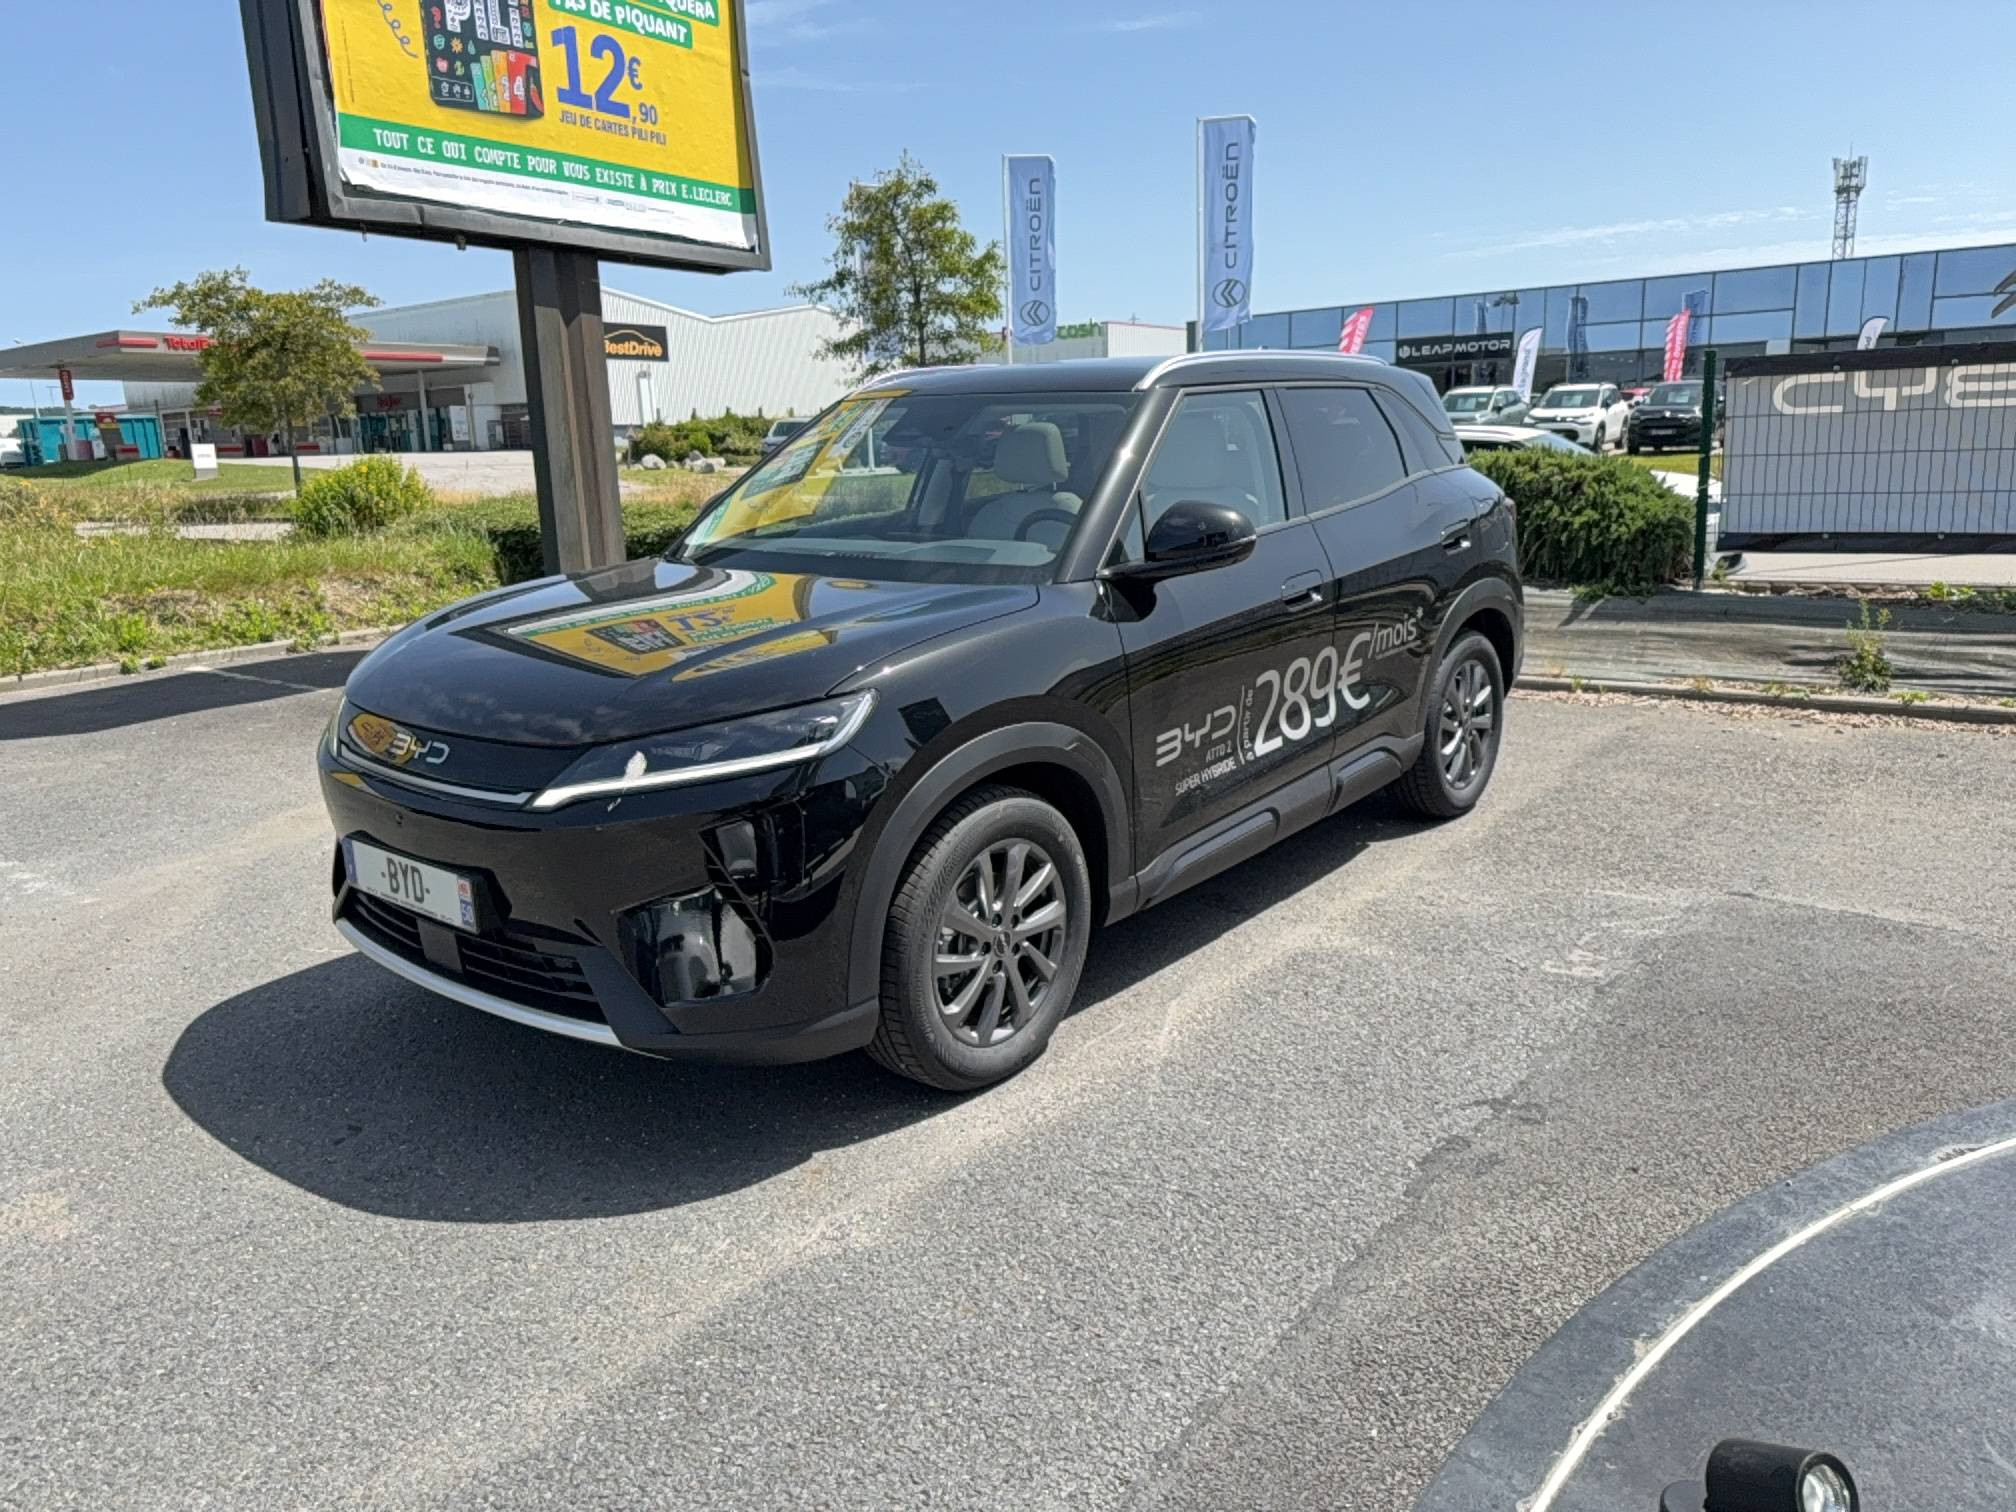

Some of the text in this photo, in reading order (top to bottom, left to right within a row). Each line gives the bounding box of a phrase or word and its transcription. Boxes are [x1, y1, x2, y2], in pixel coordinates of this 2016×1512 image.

[590, 0, 612, 21] DE
[615, 5, 688, 43] PIQUANT
[560, 110, 577, 125] JEU
[579, 114, 594, 129] DE
[594, 118, 630, 138] CARTES
[373, 128, 409, 151] TOUT
[417, 136, 436, 155] CE
[442, 141, 467, 160] QUI
[474, 146, 521, 169] COMPTE
[527, 155, 558, 175] POUR
[562, 161, 591, 181] VOUS
[595, 167, 635, 189] EXISTE
[639, 173, 648, 191] À
[652, 178, 677, 197] PRIX
[681, 184, 734, 207] E.LECLERC
[1221, 141, 1239, 270] CITROËN
[1025, 177, 1042, 292] CITROËN
[1411, 338, 1512, 358] LEAPMOTOR
[389, 733, 451, 764] BYD
[1156, 705, 1237, 767] BYD
[1206, 743, 1226, 763] ATTO
[1175, 756, 1237, 797] SUPER HYBRIDE
